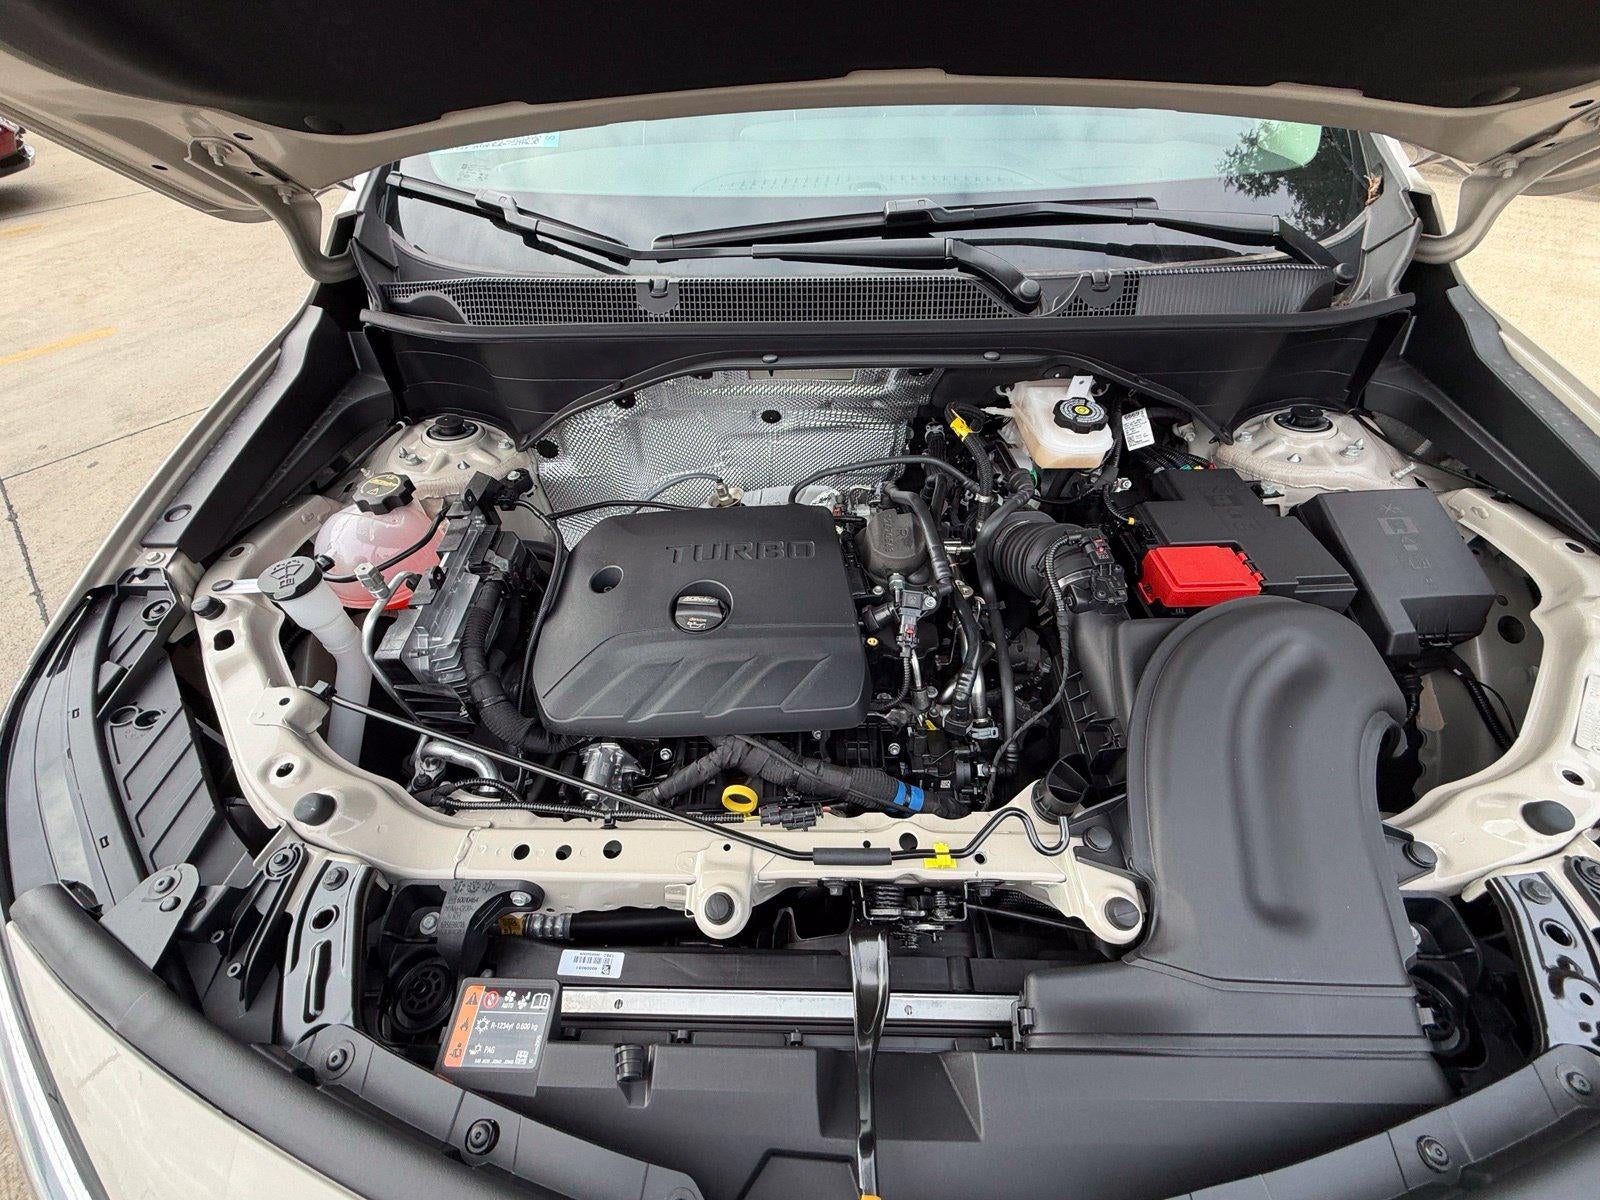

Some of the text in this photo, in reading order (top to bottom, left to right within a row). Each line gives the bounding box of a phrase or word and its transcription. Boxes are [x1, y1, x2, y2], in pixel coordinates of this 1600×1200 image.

[665, 540, 816, 564] TURBO
[490, 1021, 515, 1031] R-1234yf
[531, 1022, 539, 1032] kg
[483, 1045, 496, 1054] PAG
